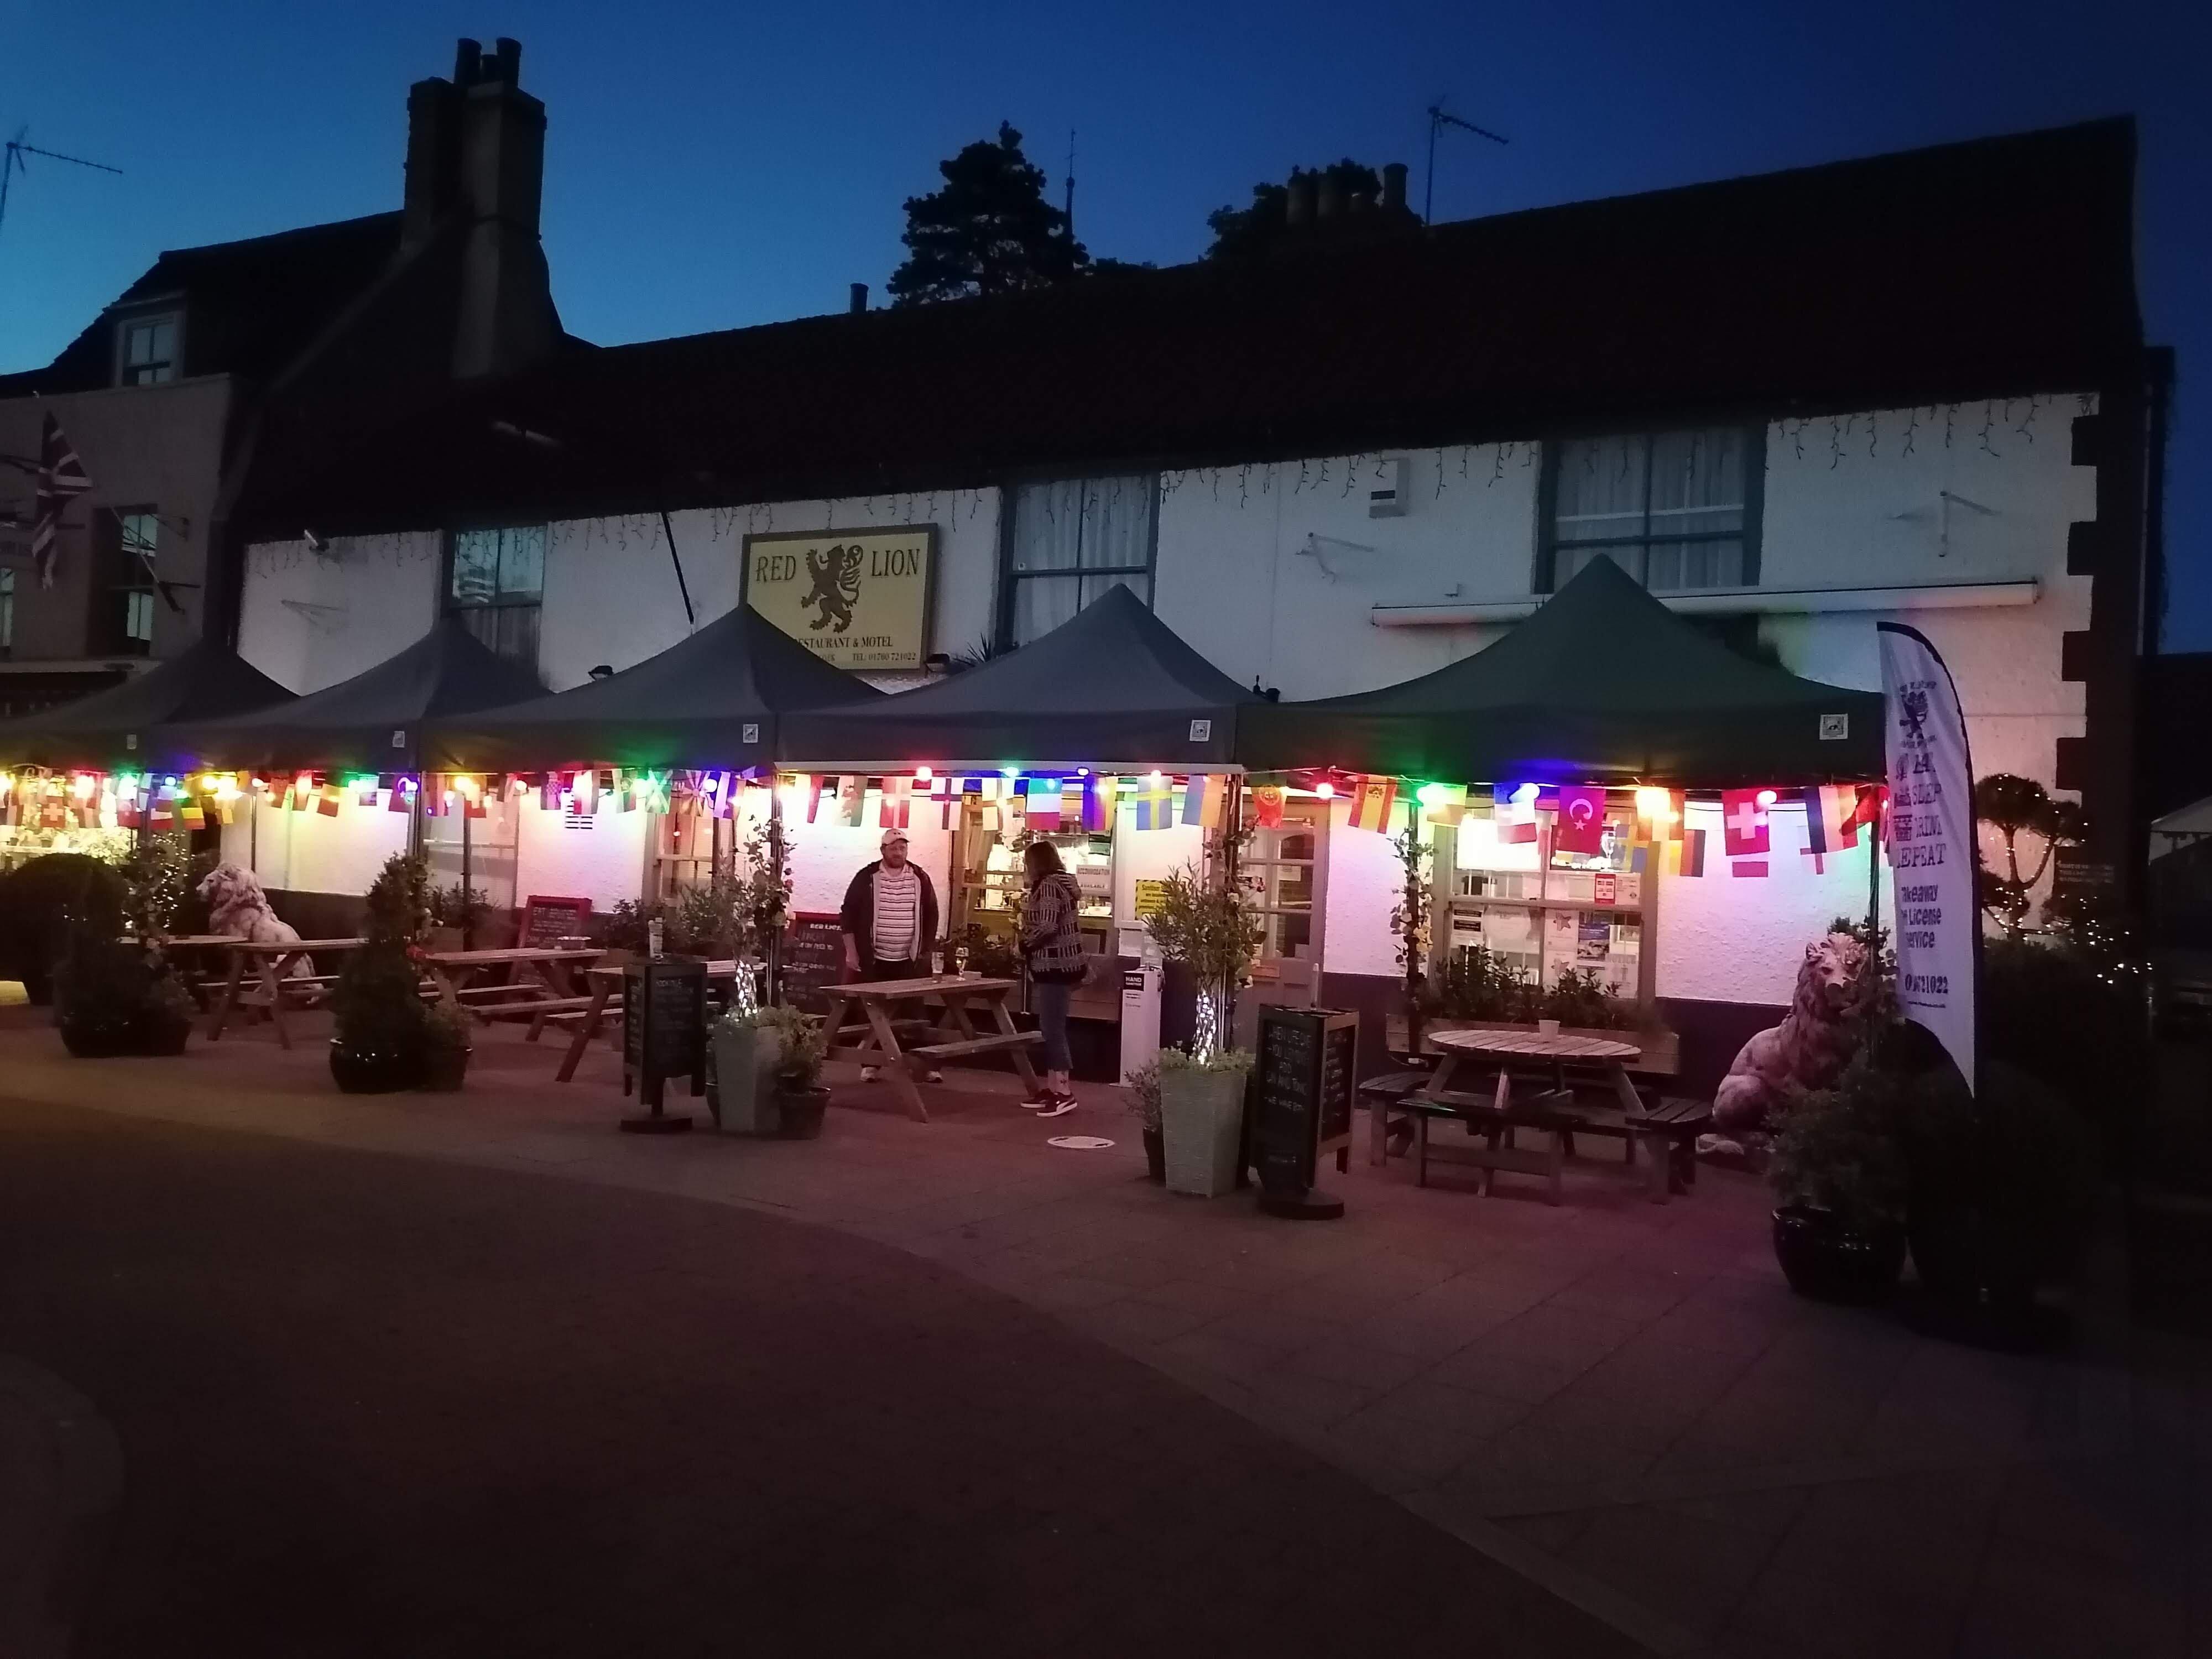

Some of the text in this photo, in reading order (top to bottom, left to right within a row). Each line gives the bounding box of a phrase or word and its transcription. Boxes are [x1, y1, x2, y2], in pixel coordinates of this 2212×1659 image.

[755, 548, 921, 583] RED LION
[797, 636, 893, 649] ESTAURANT & MOTEL
[1897, 843, 1947, 869] EPEAT
